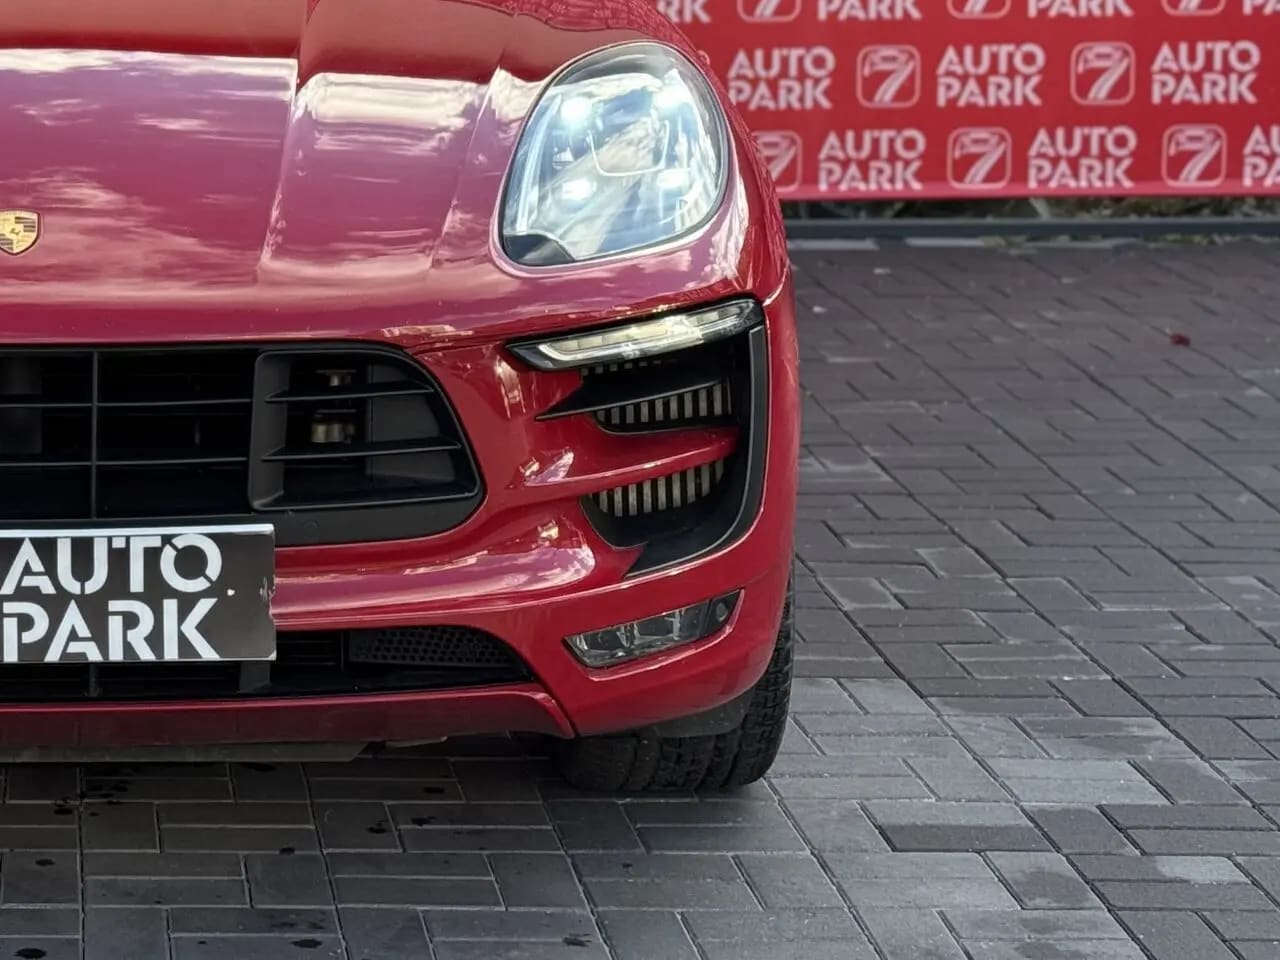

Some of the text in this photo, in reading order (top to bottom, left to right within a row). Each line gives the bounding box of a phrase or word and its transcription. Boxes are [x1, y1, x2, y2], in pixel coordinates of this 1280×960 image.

[728, 46, 835, 79] AUTO
[937, 43, 1045, 75] AUTO
[1152, 41, 1260, 73] AUTO
[937, 75, 1041, 107] PARK
[1152, 72, 1256, 104] PARK
[819, 129, 925, 160] AUTO
[1028, 126, 1136, 158] AUTO
[818, 159, 922, 191] PARK
[1027, 157, 1132, 189] PARK
[0, 534, 222, 595] AUTO
[3, 598, 221, 662] PARK
